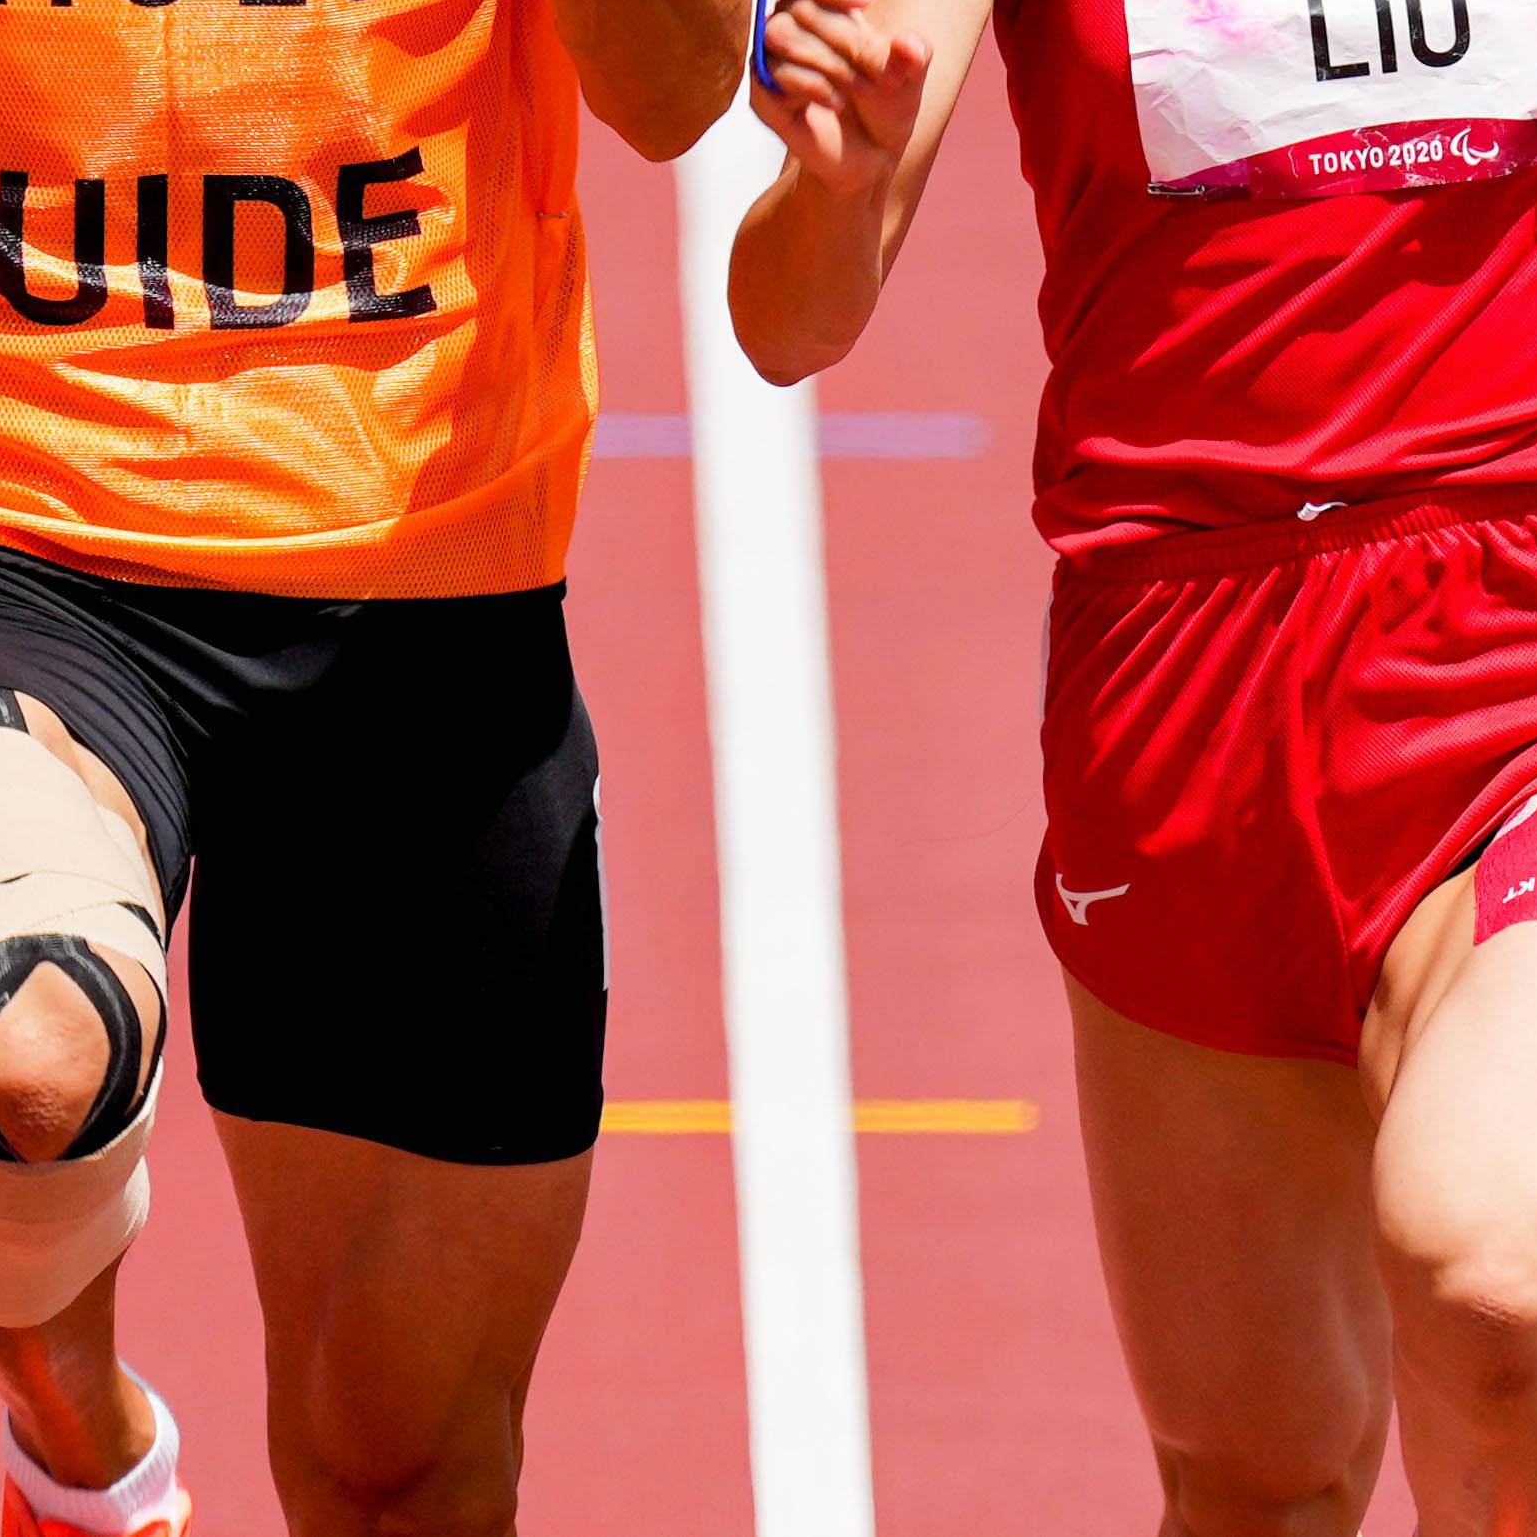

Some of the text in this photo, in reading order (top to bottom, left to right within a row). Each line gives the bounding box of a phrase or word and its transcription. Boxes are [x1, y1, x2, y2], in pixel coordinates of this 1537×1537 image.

[1308, 139, 1444, 175] TOKYO 2020
[1502, 877, 1536, 904] KT
